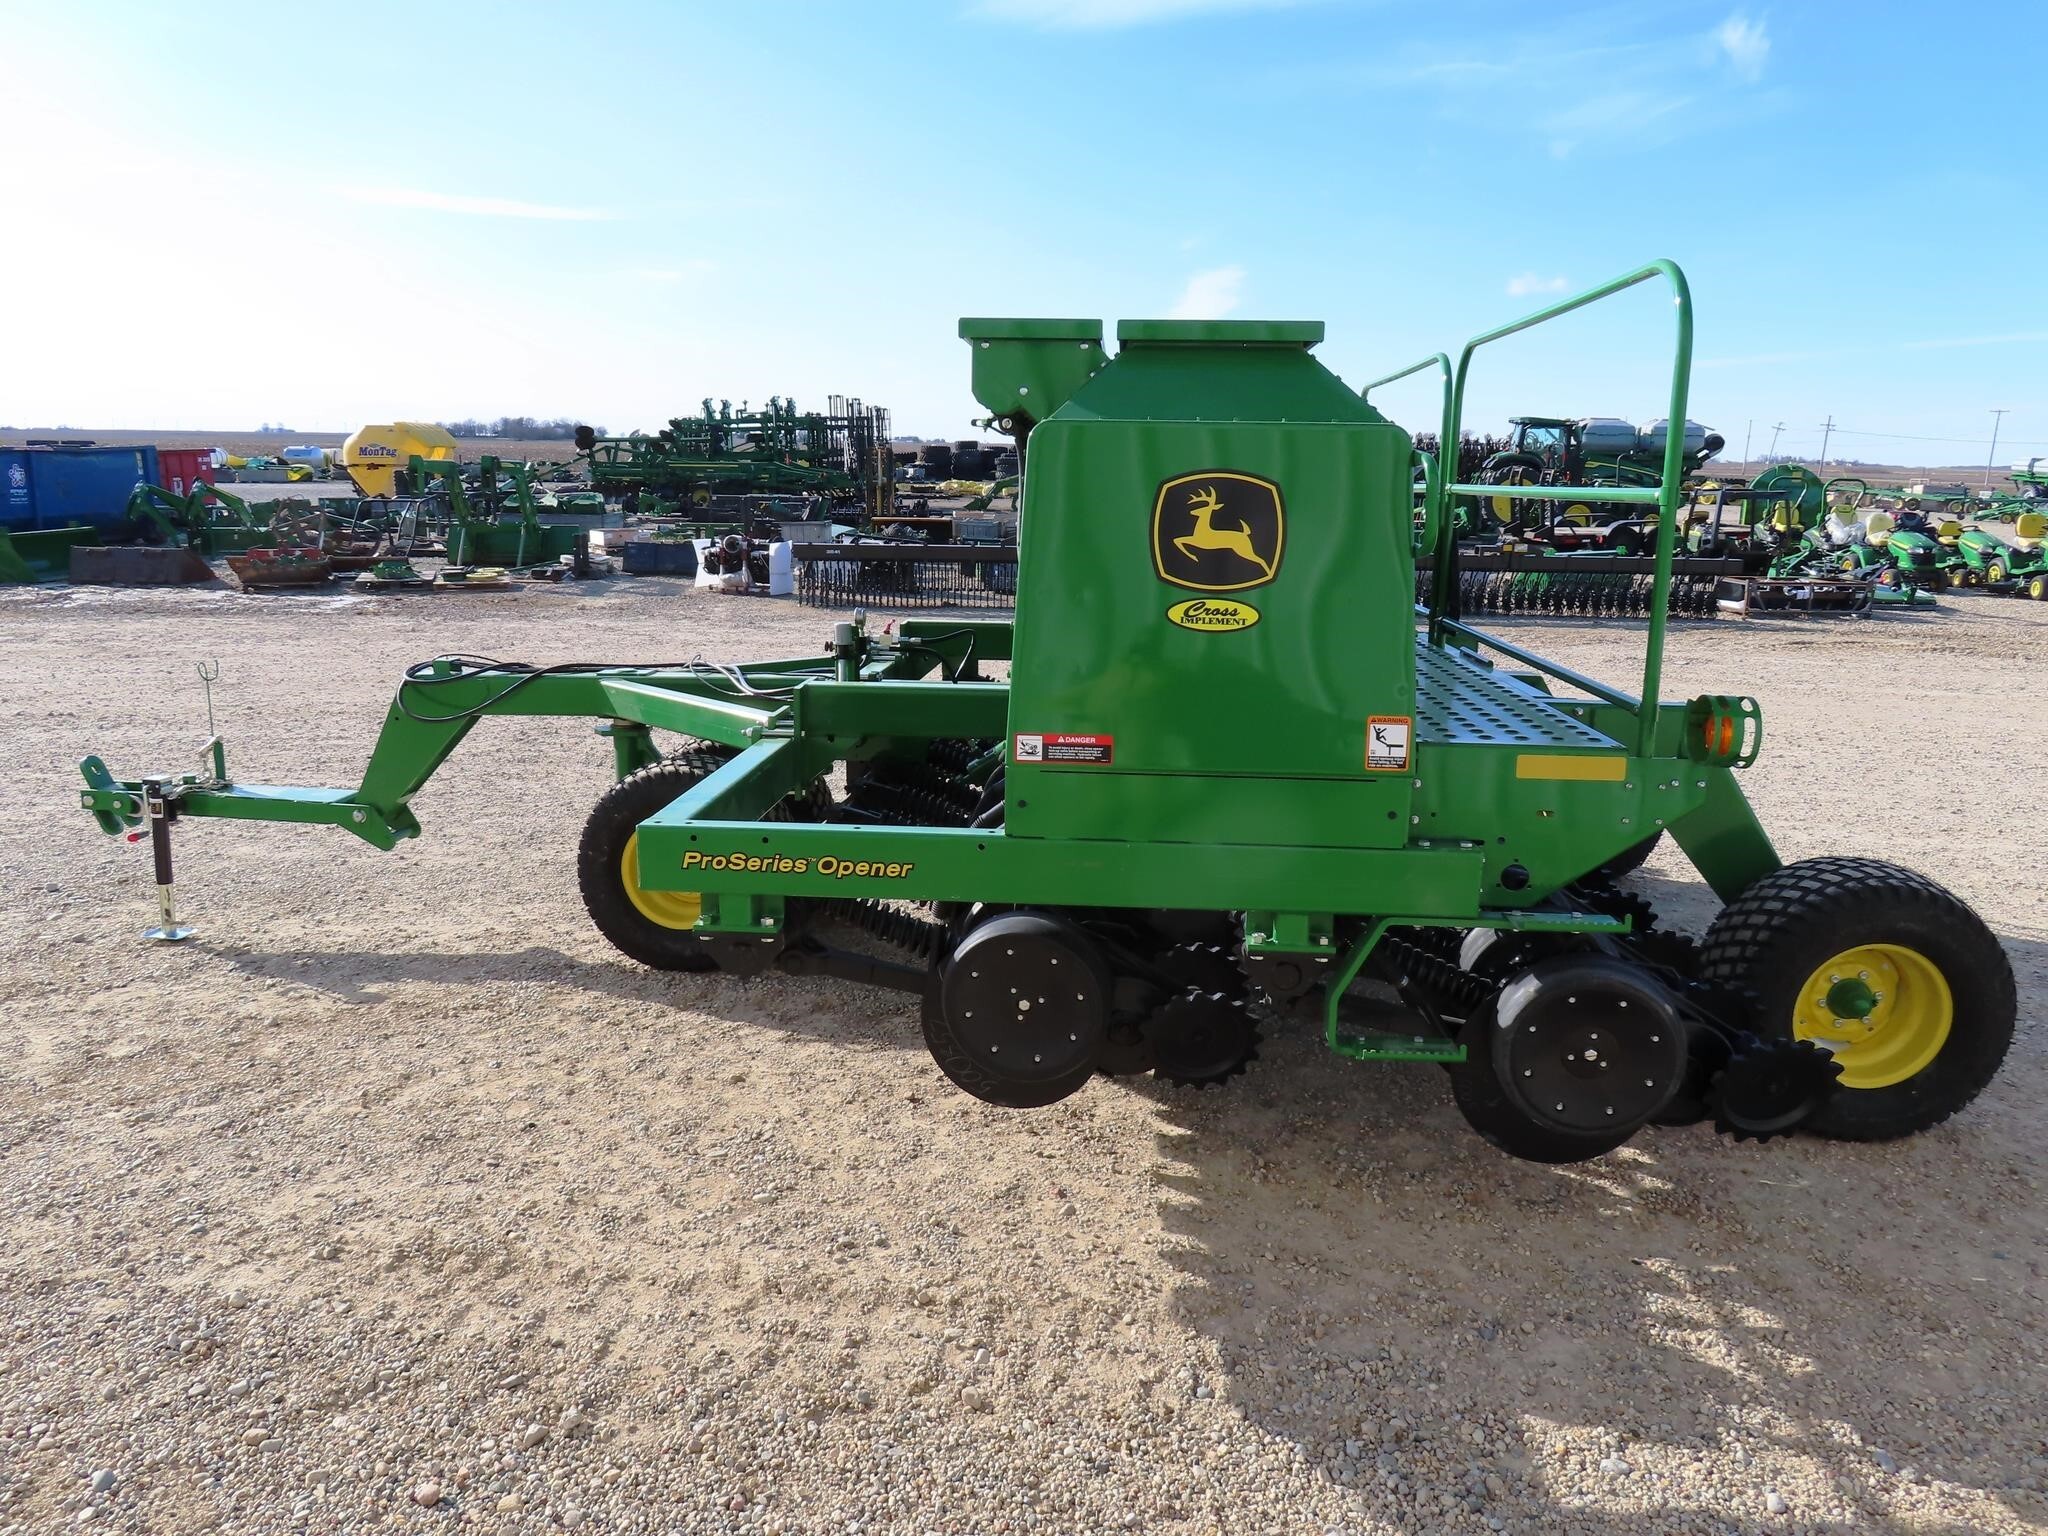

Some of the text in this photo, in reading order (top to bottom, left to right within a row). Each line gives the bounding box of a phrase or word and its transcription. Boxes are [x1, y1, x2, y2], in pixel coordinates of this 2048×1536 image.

[359, 446, 397, 457] MonTag
[1183, 600, 1241, 617] Cross
[1180, 616, 1248, 626] IMPLEMENT
[1065, 736, 1096, 744] DANGER
[817, 856, 914, 879] Opener
